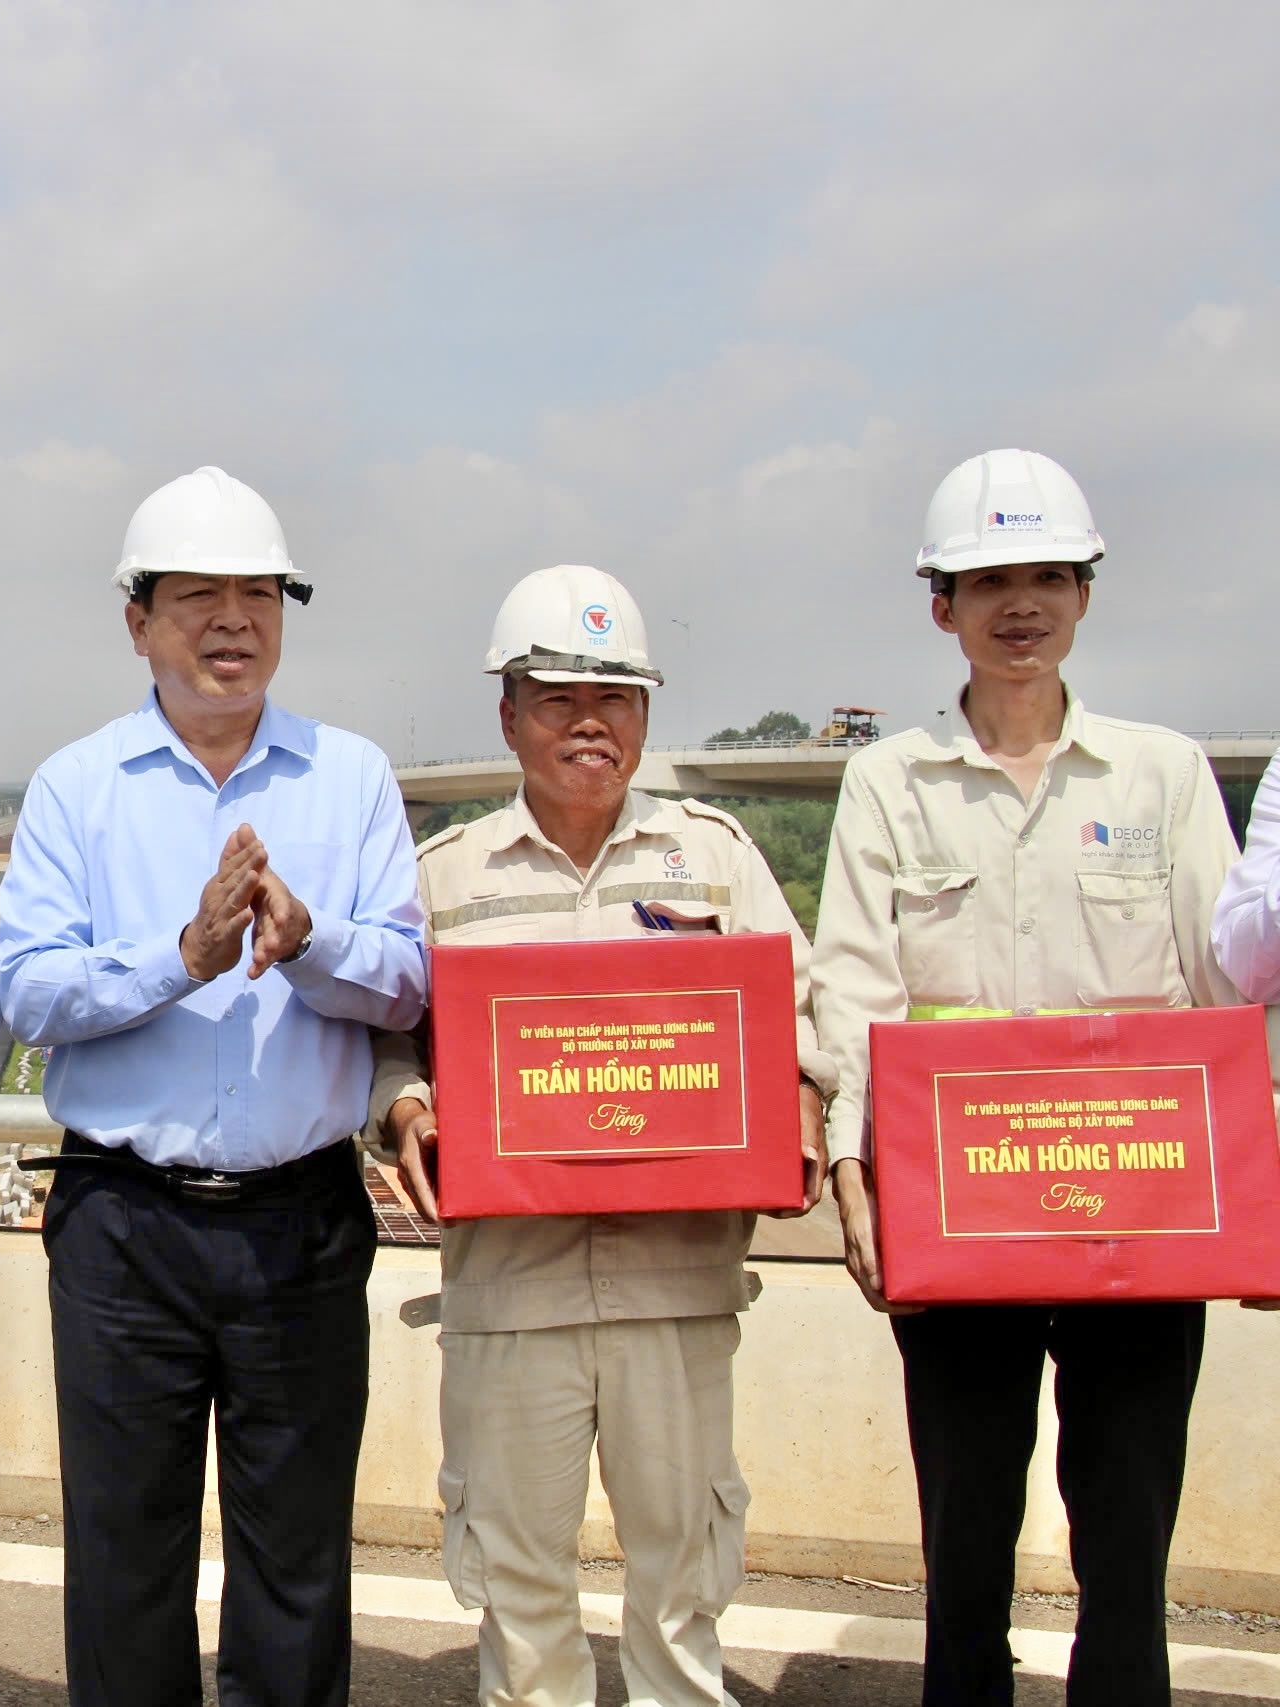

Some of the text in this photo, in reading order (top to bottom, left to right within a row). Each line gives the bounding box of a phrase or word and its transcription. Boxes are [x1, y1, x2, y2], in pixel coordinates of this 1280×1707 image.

[1007, 514, 1042, 522] DEOCA
[588, 637, 608, 646] TEDI
[662, 870, 692, 880] TEDI
[520, 1019, 715, 1039] ỦY VIÊN BAN CHẤP HÀNH TRUNG ƯƠNG ĐẢNG
[562, 1039, 576, 1054] BỘ
[616, 1038, 629, 1053] BỘ
[630, 1036, 648, 1050] XÂY
[649, 1038, 675, 1051] DỰNG
[519, 1057, 719, 1095] TRẦN HỒNG MINH
[964, 1096, 1179, 1116] ỦY VIÊN BAN CHẤP HÀNH TRUNG ƯƠNG ĐẢNG
[588, 1103, 648, 1135] Tặng
[1009, 1113, 1134, 1132] BỘ TRƯỞNG BỘ XÂY DỰNG
[963, 1135, 1185, 1174] TRẦN HỒNG MINH
[1041, 1183, 1106, 1217] Tặng
